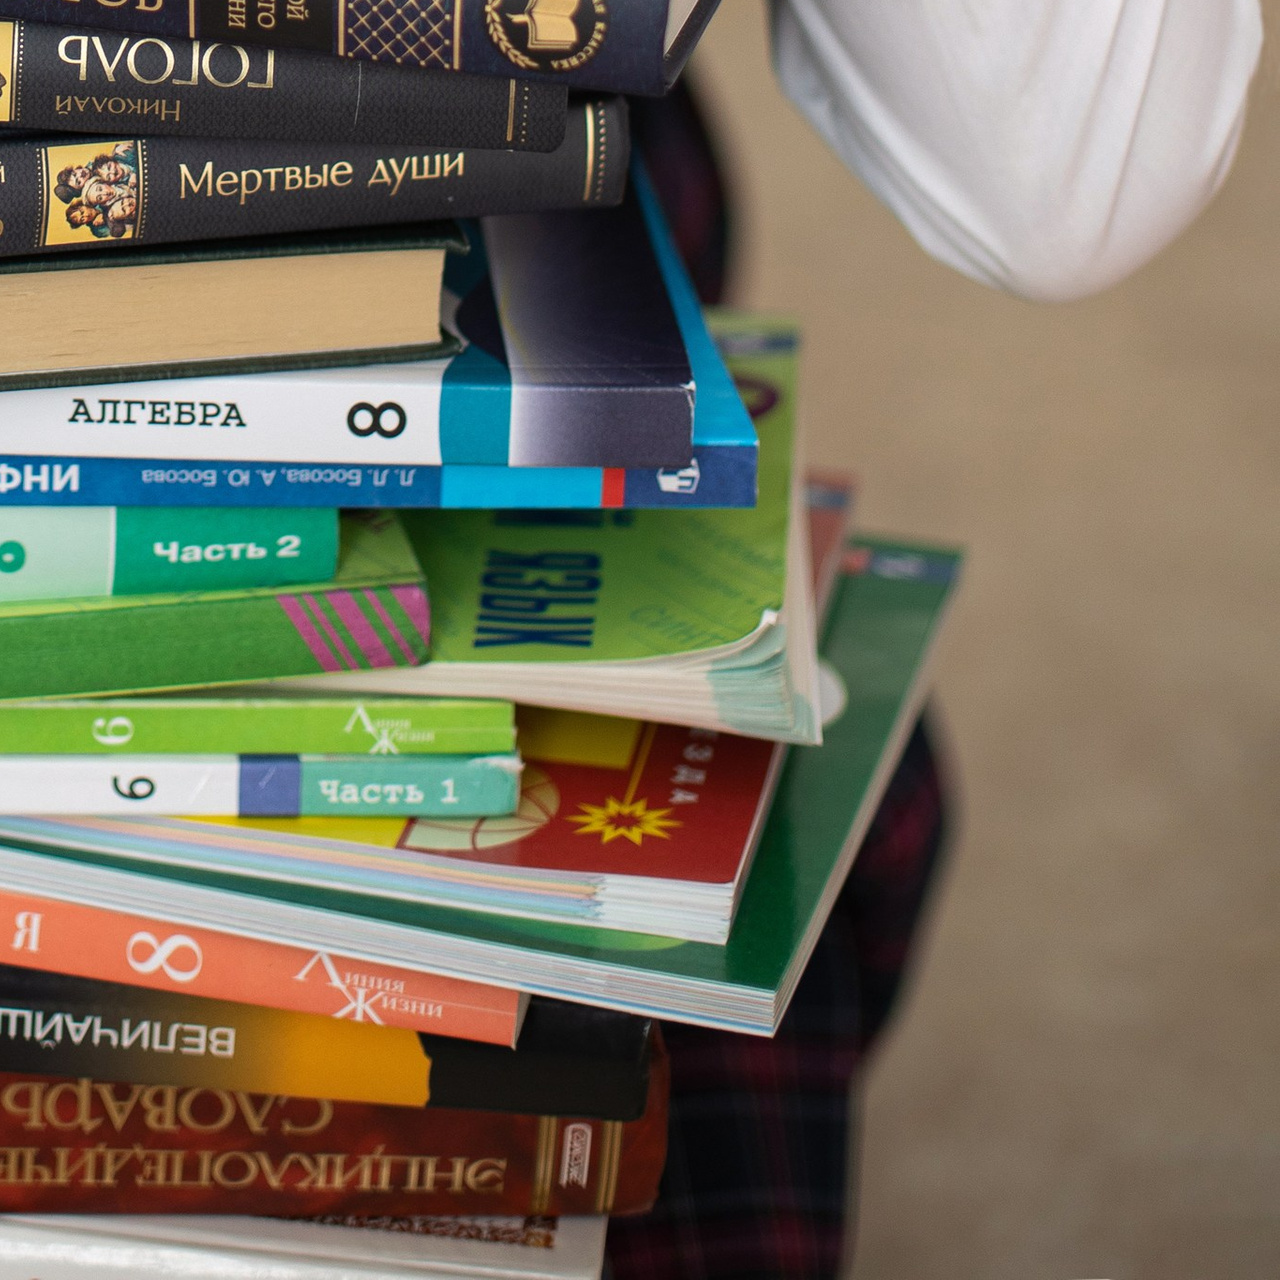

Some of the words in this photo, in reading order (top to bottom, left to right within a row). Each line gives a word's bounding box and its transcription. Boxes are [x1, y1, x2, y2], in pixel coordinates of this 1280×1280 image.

[57, 35, 275, 88] ГОГОЛЬ
[179, 161, 353, 207] Мертвые
[368, 152, 465, 192] души
[67, 399, 247, 428] АЛГЕБРА
[346, 401, 408, 439] 8
[141, 469, 217, 488] Босова
[223, 470, 251, 487] Ю.
[255, 469, 277, 487] А.
[280, 468, 362, 487] Босова,
[367, 469, 390, 487] Л.
[394, 469, 417, 487] Л.
[153, 539, 266, 564] Часть
[276, 535, 301, 559] 2
[319, 778, 424, 804] Часть
[439, 778, 460, 803] 1
[125, 930, 203, 983] 8
[292, 950, 406, 993] Линия
[332, 986, 444, 1026] Жизни
[0, 1078, 335, 1135] СЛОВАРЬ
